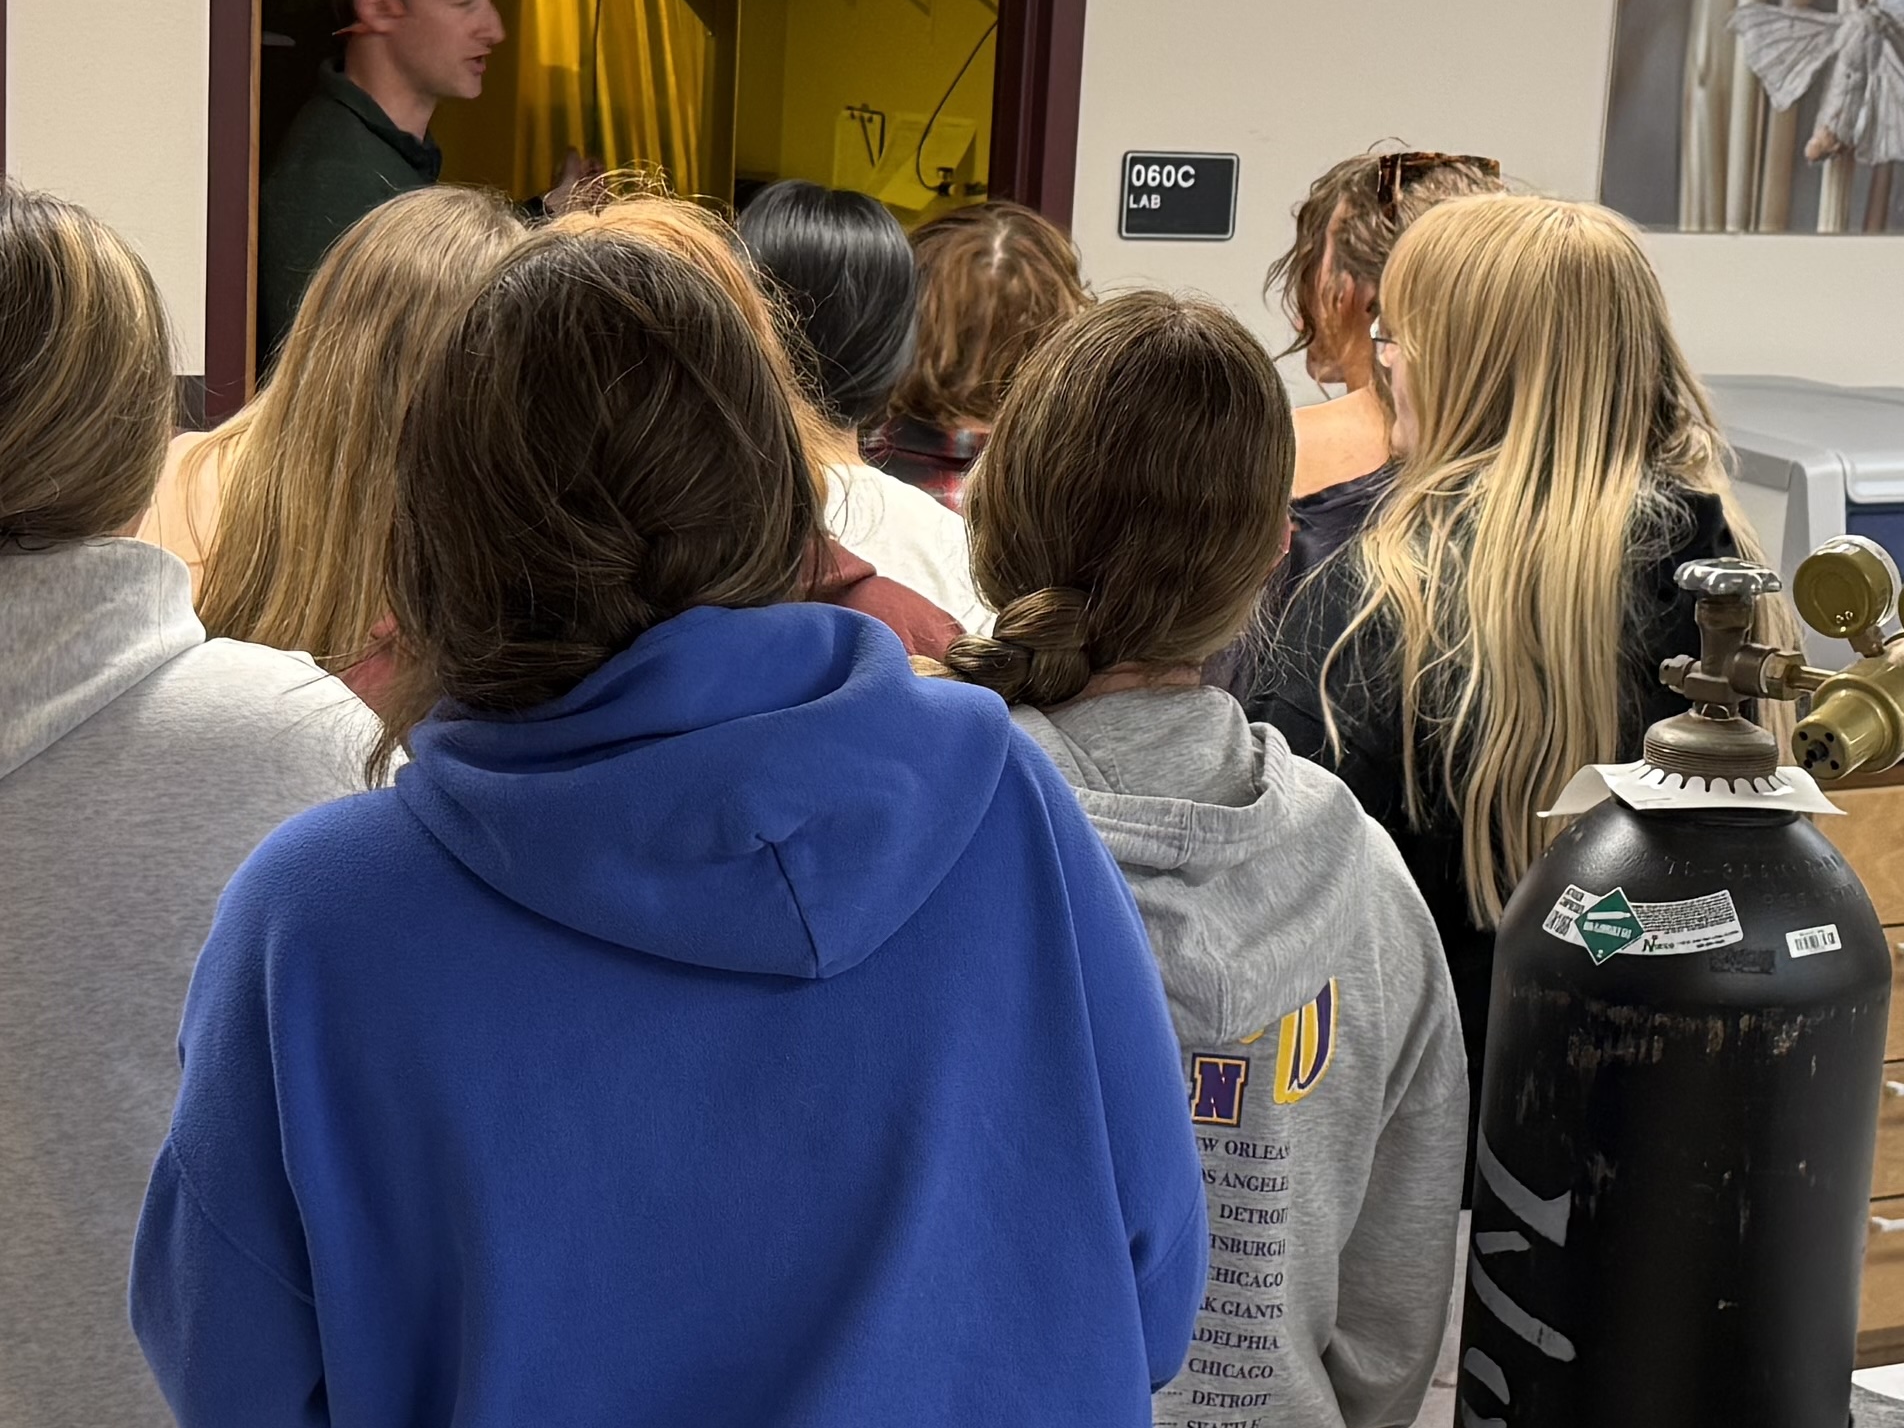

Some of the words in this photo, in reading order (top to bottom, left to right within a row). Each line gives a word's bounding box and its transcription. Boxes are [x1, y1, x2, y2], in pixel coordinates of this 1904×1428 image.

[1130, 163, 1196, 189] 060C
[1128, 194, 1162, 209] LAB
[1218, 1172, 1290, 1193] ANGELE
[1221, 1299, 1284, 1320] GIANTS
[1188, 1357, 1274, 1380] CHICAGO
[1191, 1388, 1272, 1409] DETROIT
